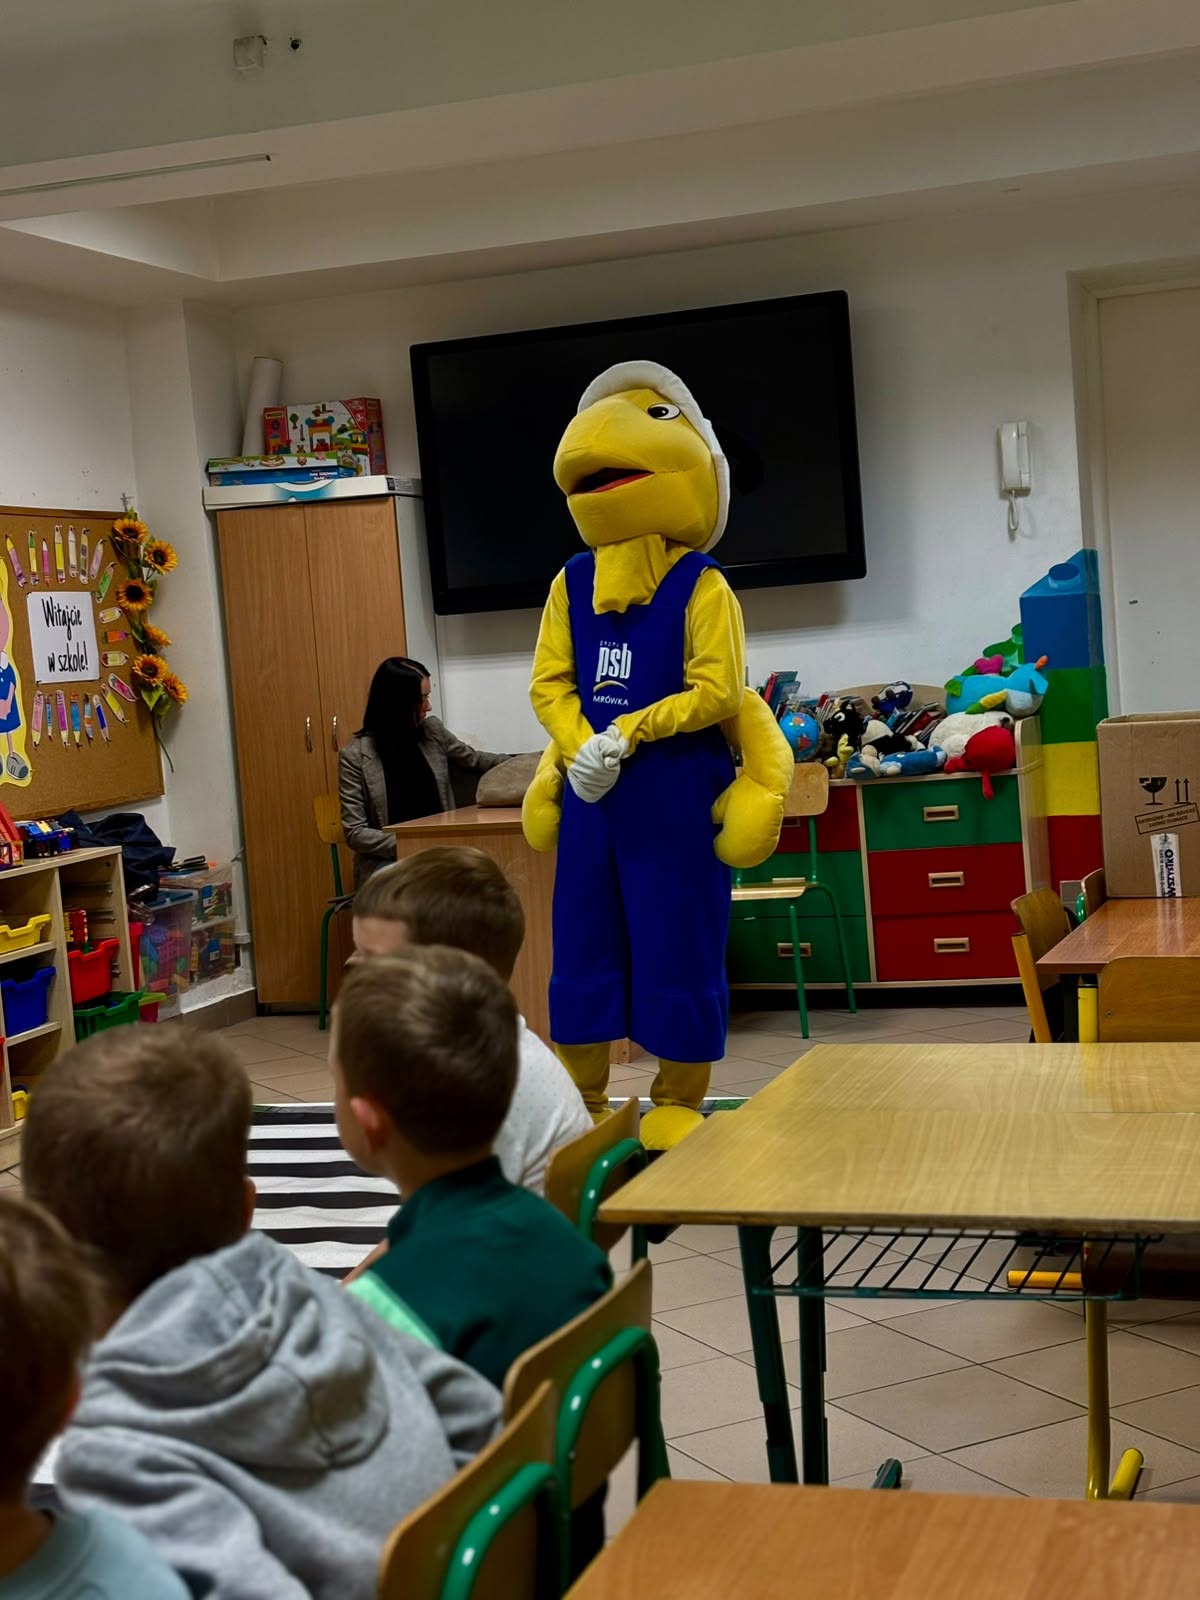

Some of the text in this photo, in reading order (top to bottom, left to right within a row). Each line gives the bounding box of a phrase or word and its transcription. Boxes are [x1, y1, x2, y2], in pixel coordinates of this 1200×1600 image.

[41, 596, 82, 640] Witajcie
[48, 641, 88, 672] w szkole!
[595, 643, 632, 682] psb
[593, 695, 629, 706] MRÓWKA
[1164, 849, 1176, 897] WSZYSTKO
